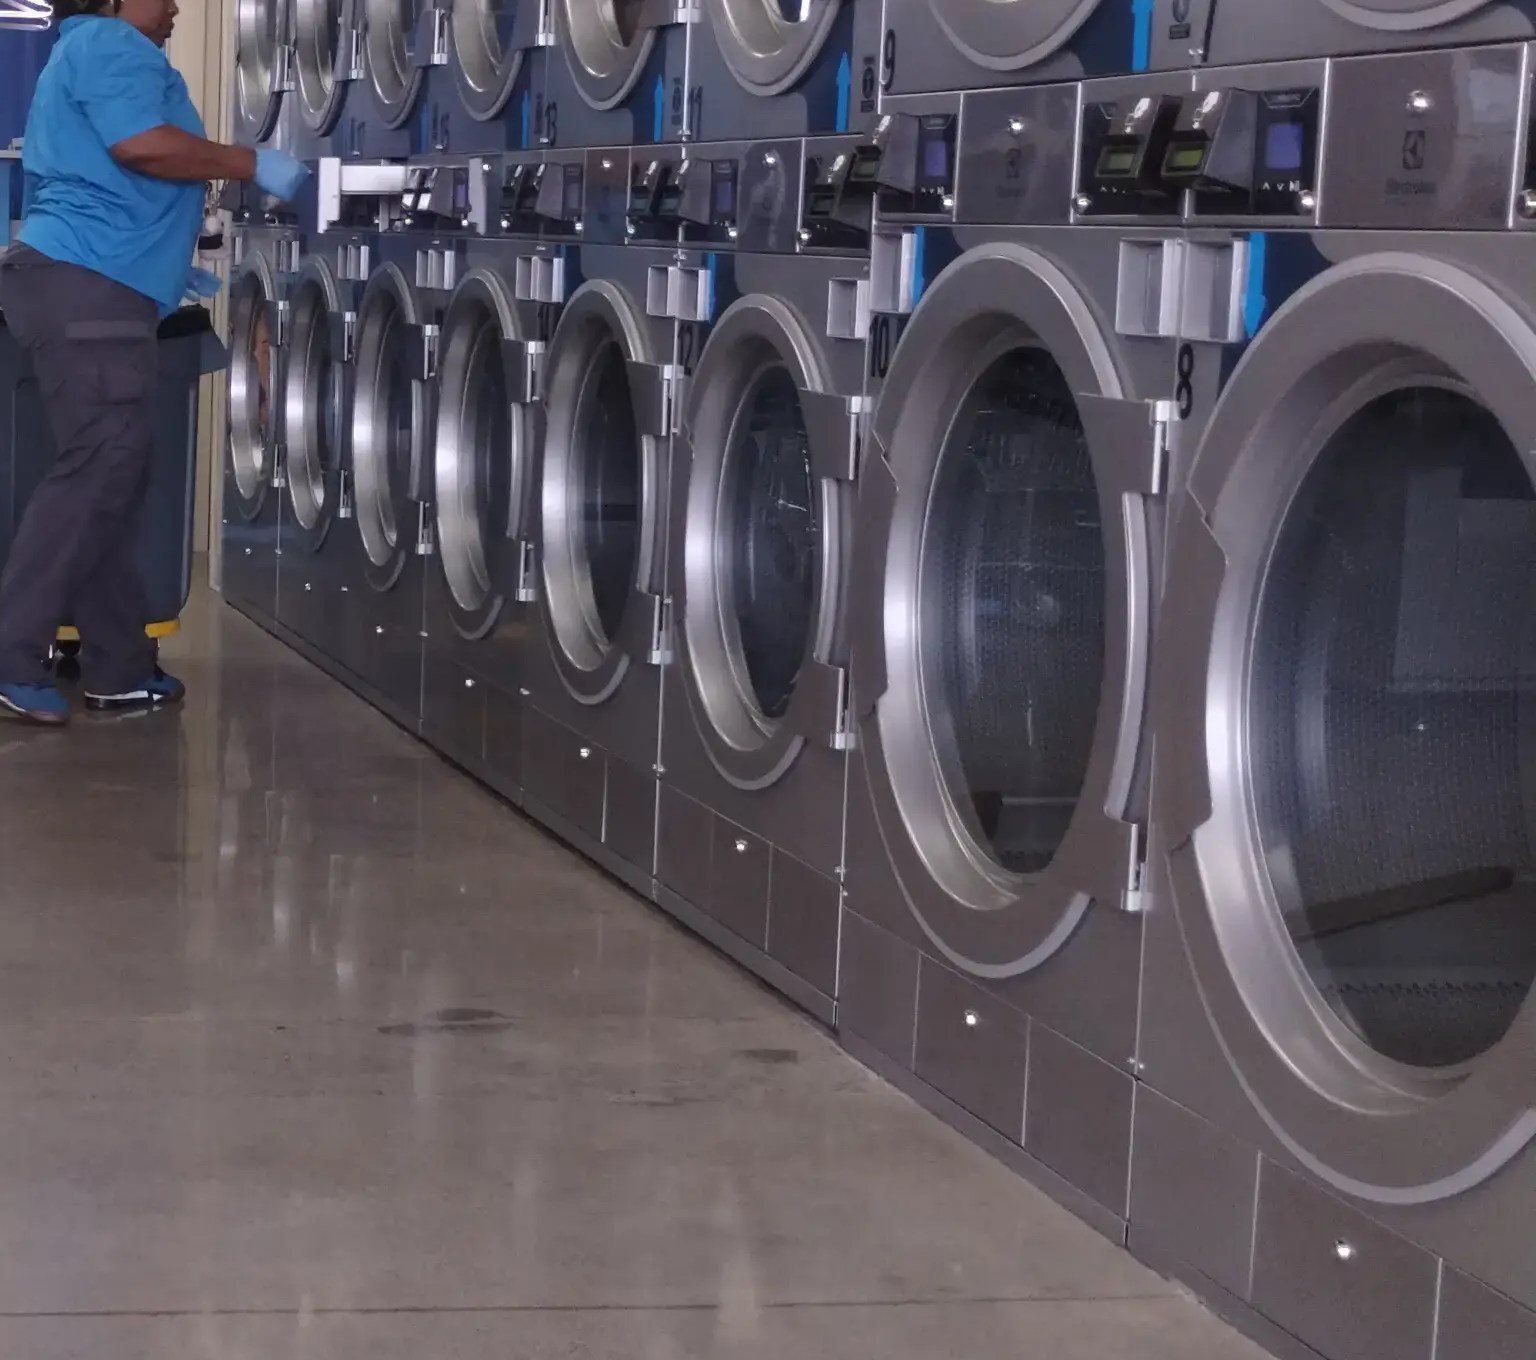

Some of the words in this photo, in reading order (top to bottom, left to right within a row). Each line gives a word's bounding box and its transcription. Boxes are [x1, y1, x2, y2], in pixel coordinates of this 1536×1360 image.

[885, 28, 896, 90] 9
[870, 312, 889, 378] 10
[1176, 343, 1194, 420] 8
